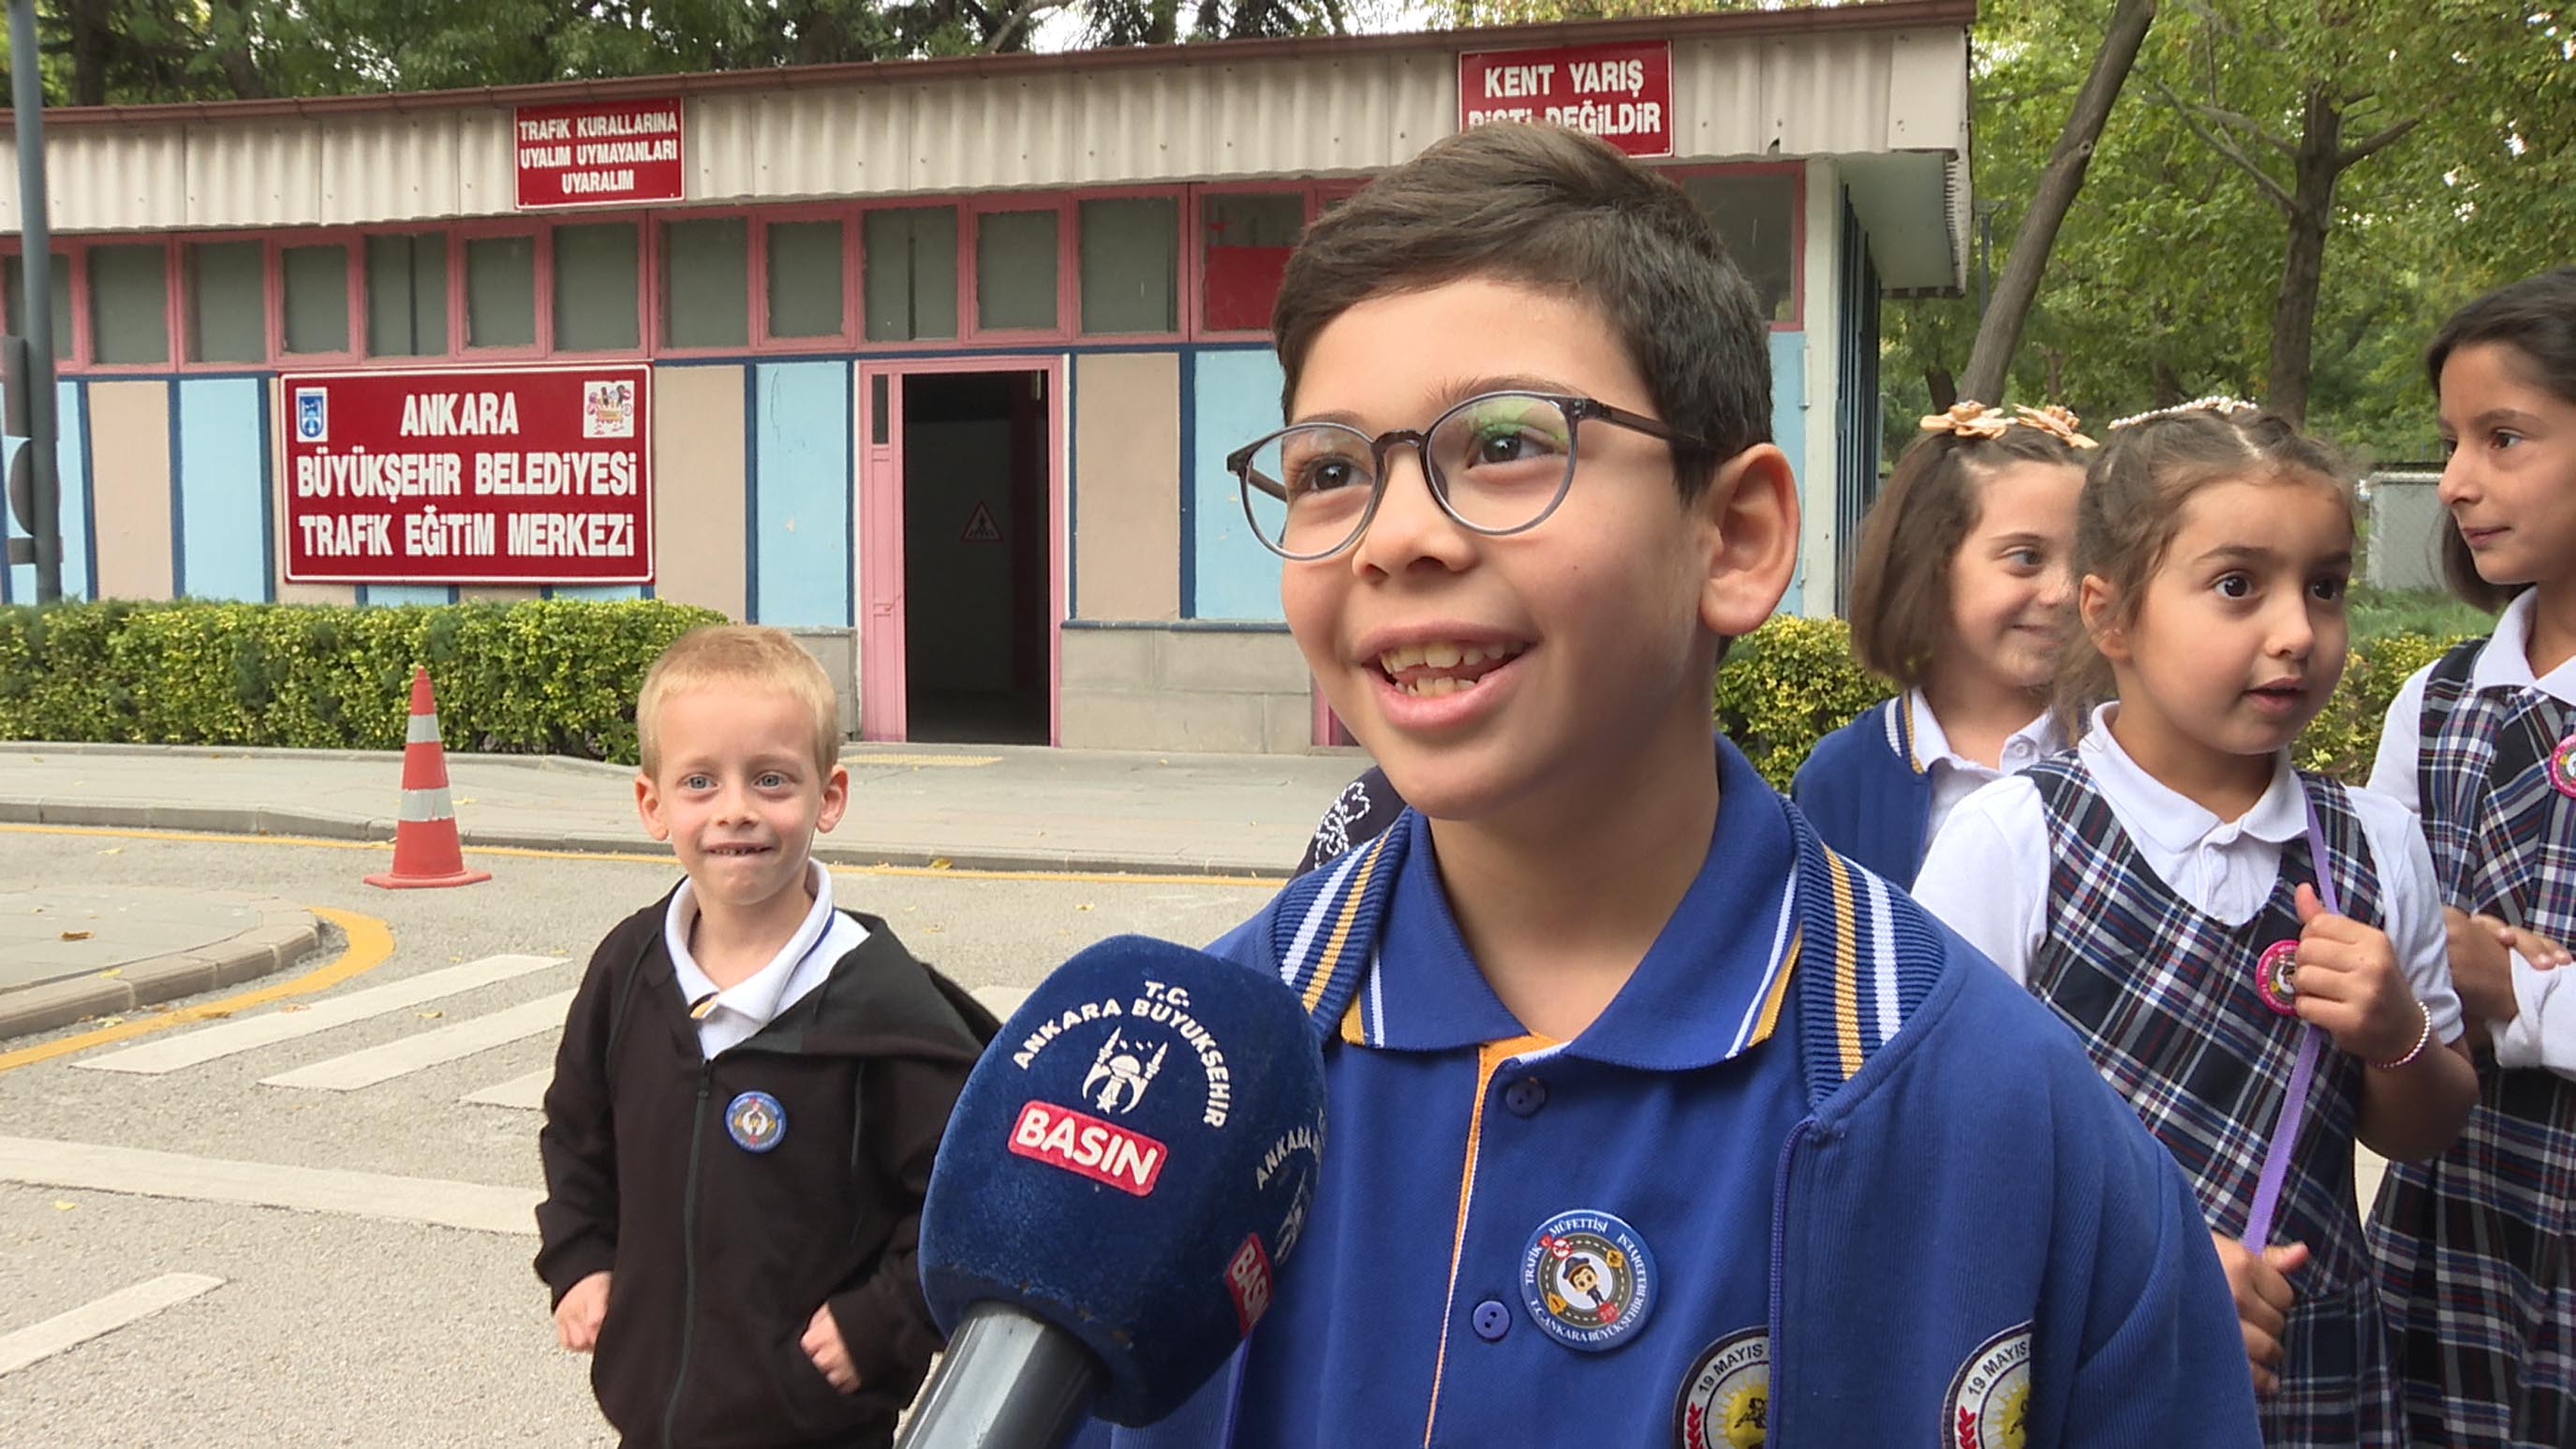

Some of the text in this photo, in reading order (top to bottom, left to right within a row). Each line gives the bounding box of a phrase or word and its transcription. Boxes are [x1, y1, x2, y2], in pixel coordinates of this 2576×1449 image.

[1485, 59, 1644, 98] KENT YARIŞ
[519, 111, 677, 141] TRAFİK KURALLARINA
[520, 140, 676, 169] UYALIM UYMAYANLARI
[562, 170, 634, 194] UYARALIM
[400, 392, 519, 436] ANKARA
[296, 446, 637, 503] BÜYÜKŞEHİR BELEDİYESİ
[299, 504, 634, 556] TRAFİK EĞİTİM MERKEZİ
[1145, 981, 1191, 1007] T.C.
[1013, 998, 1122, 1070] ANKARA
[1015, 1108, 1159, 1186] BASIN
[1232, 1243, 1268, 1323] BAS
[1525, 1243, 1543, 1285] TRAFİK
[1698, 1343, 1763, 1393] 19 MAYIS
[1968, 1341, 2027, 1396] 19 MAYIS
